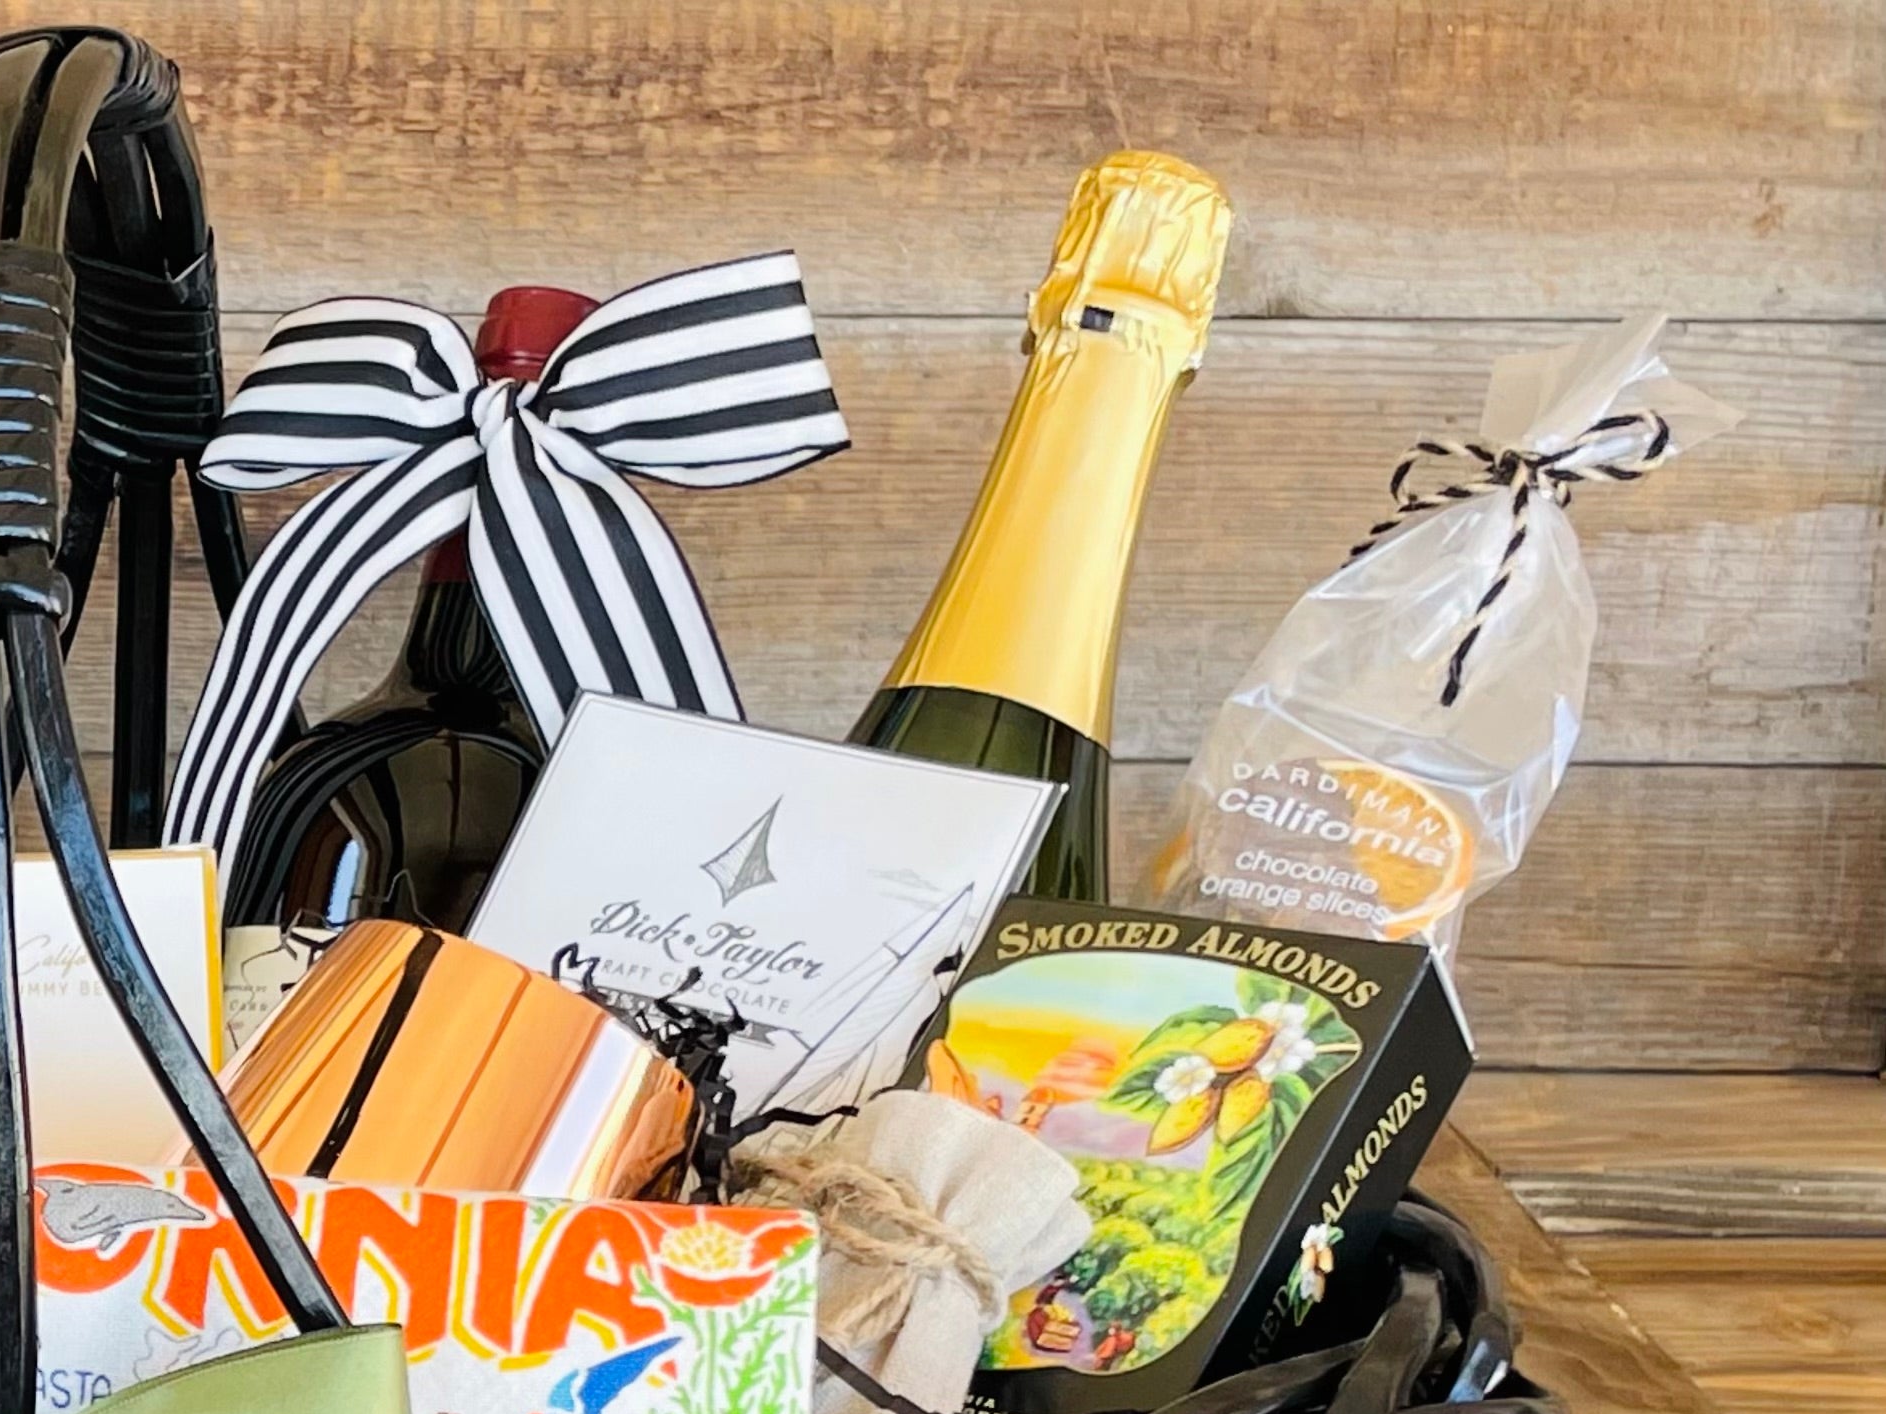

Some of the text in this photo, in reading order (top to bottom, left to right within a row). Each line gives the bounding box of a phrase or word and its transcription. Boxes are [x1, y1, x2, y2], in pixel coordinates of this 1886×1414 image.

[1217, 787, 1447, 868] california
[1200, 875, 1396, 927] orange slices
[1234, 849, 1379, 895] chocolate
[590, 898, 825, 985] Dick Taylor
[601, 958, 652, 981] RAFT
[996, 920, 1382, 1010] SMOKED ALMONDS
[1320, 1074, 1428, 1224] ALMONDS
